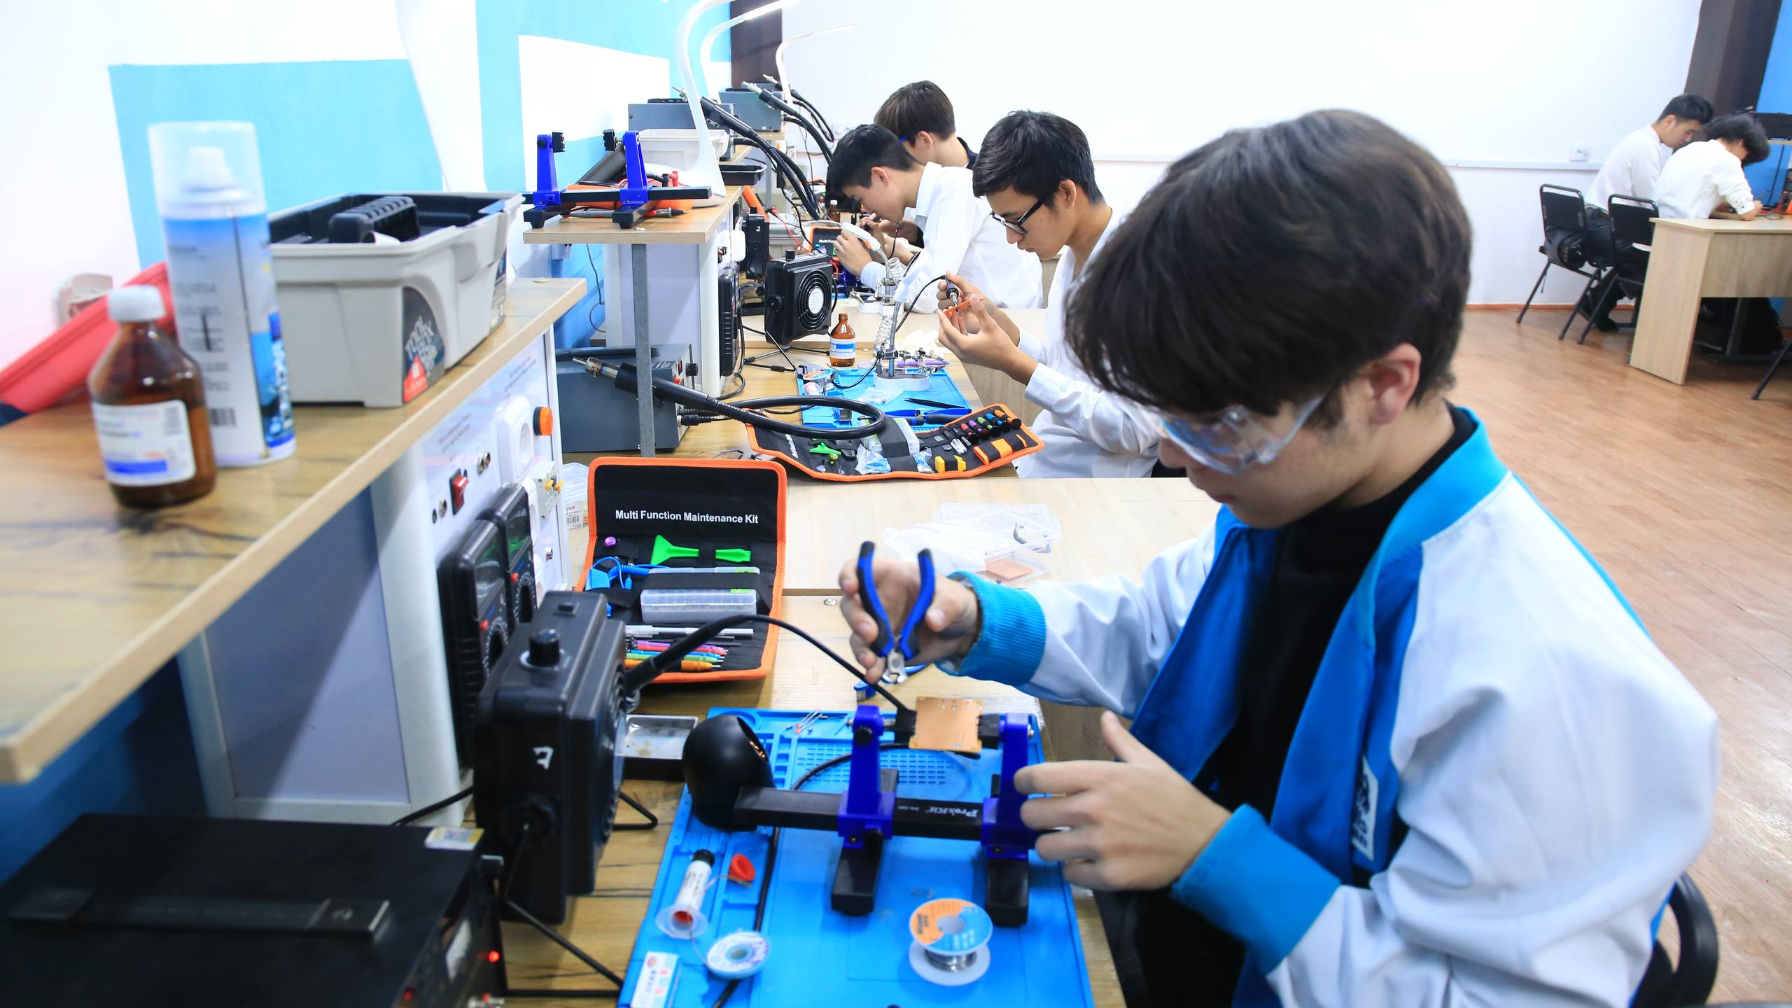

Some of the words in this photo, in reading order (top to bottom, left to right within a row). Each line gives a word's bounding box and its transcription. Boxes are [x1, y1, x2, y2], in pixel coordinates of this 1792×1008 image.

[615, 510, 639, 520] Multi
[640, 510, 682, 521] Function
[683, 512, 743, 523] Maintenance
[745, 514, 759, 524] Kit
